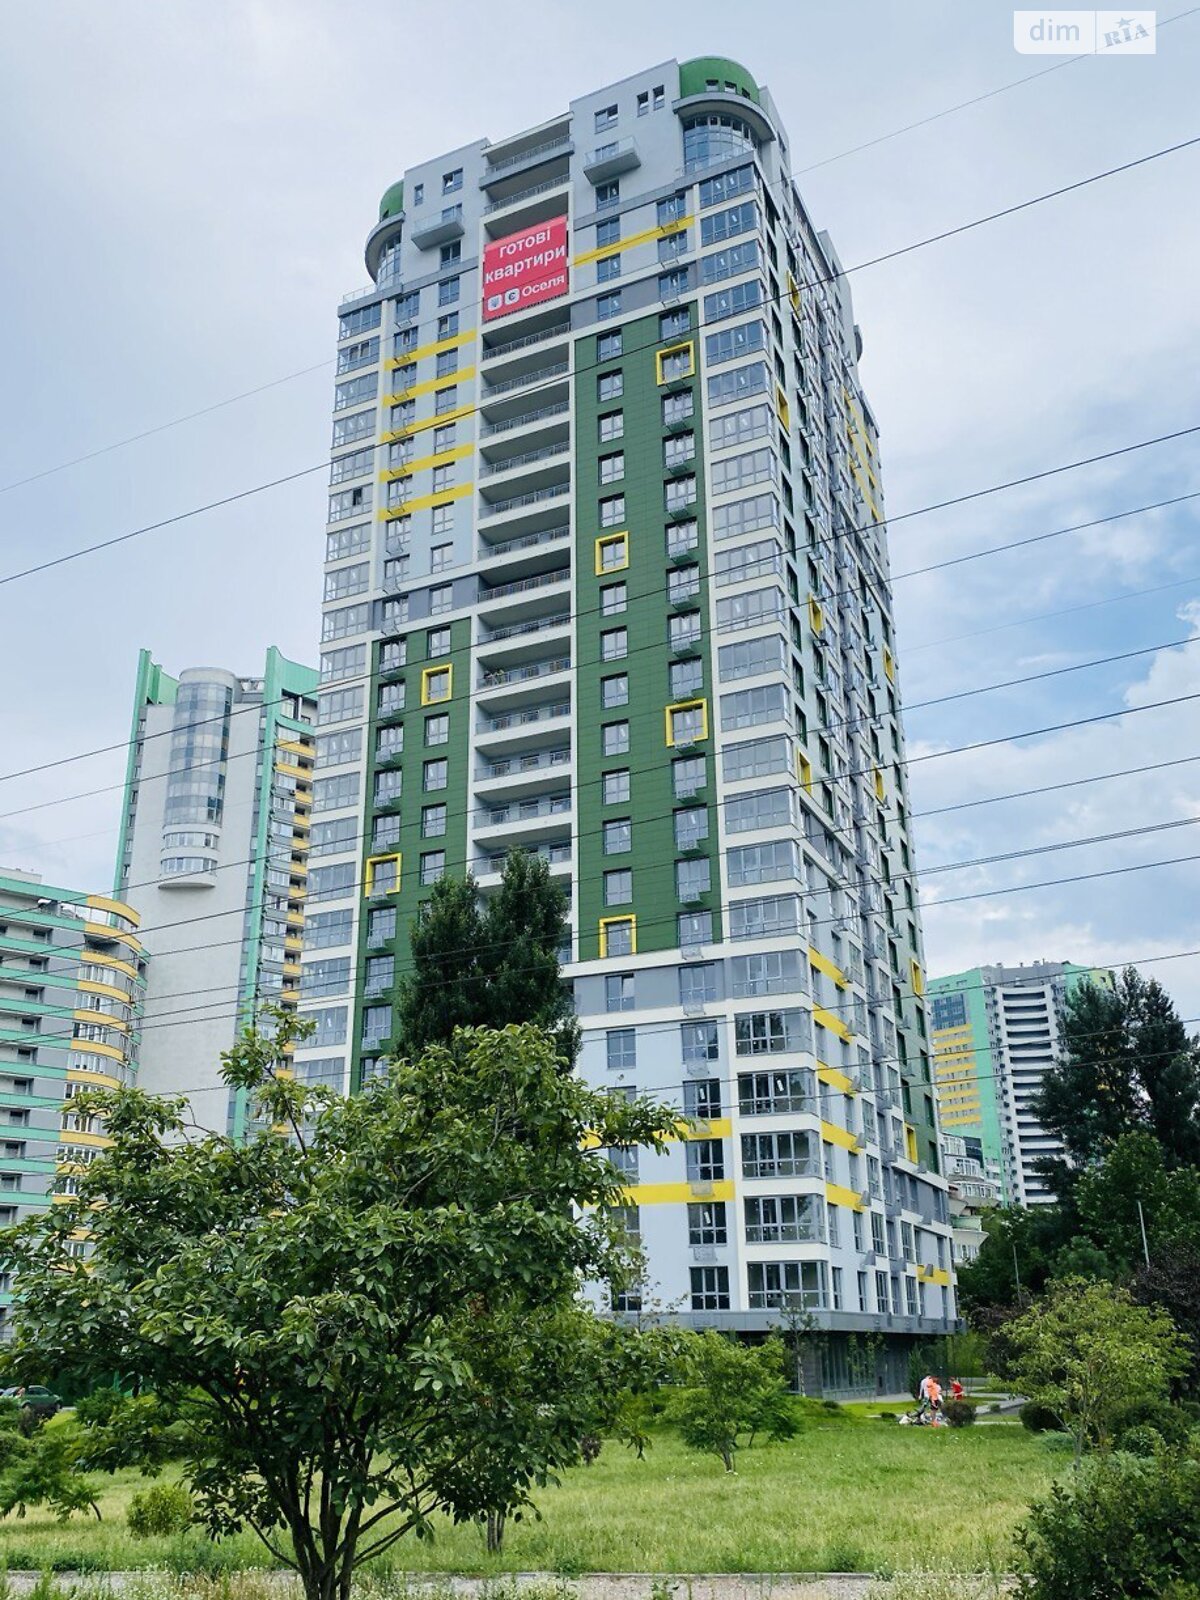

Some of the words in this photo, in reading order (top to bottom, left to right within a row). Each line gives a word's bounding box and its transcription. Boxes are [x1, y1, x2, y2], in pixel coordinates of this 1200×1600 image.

[500, 227, 551, 258] готові
[485, 245, 565, 284] квартири
[522, 275, 565, 297] Оселя
